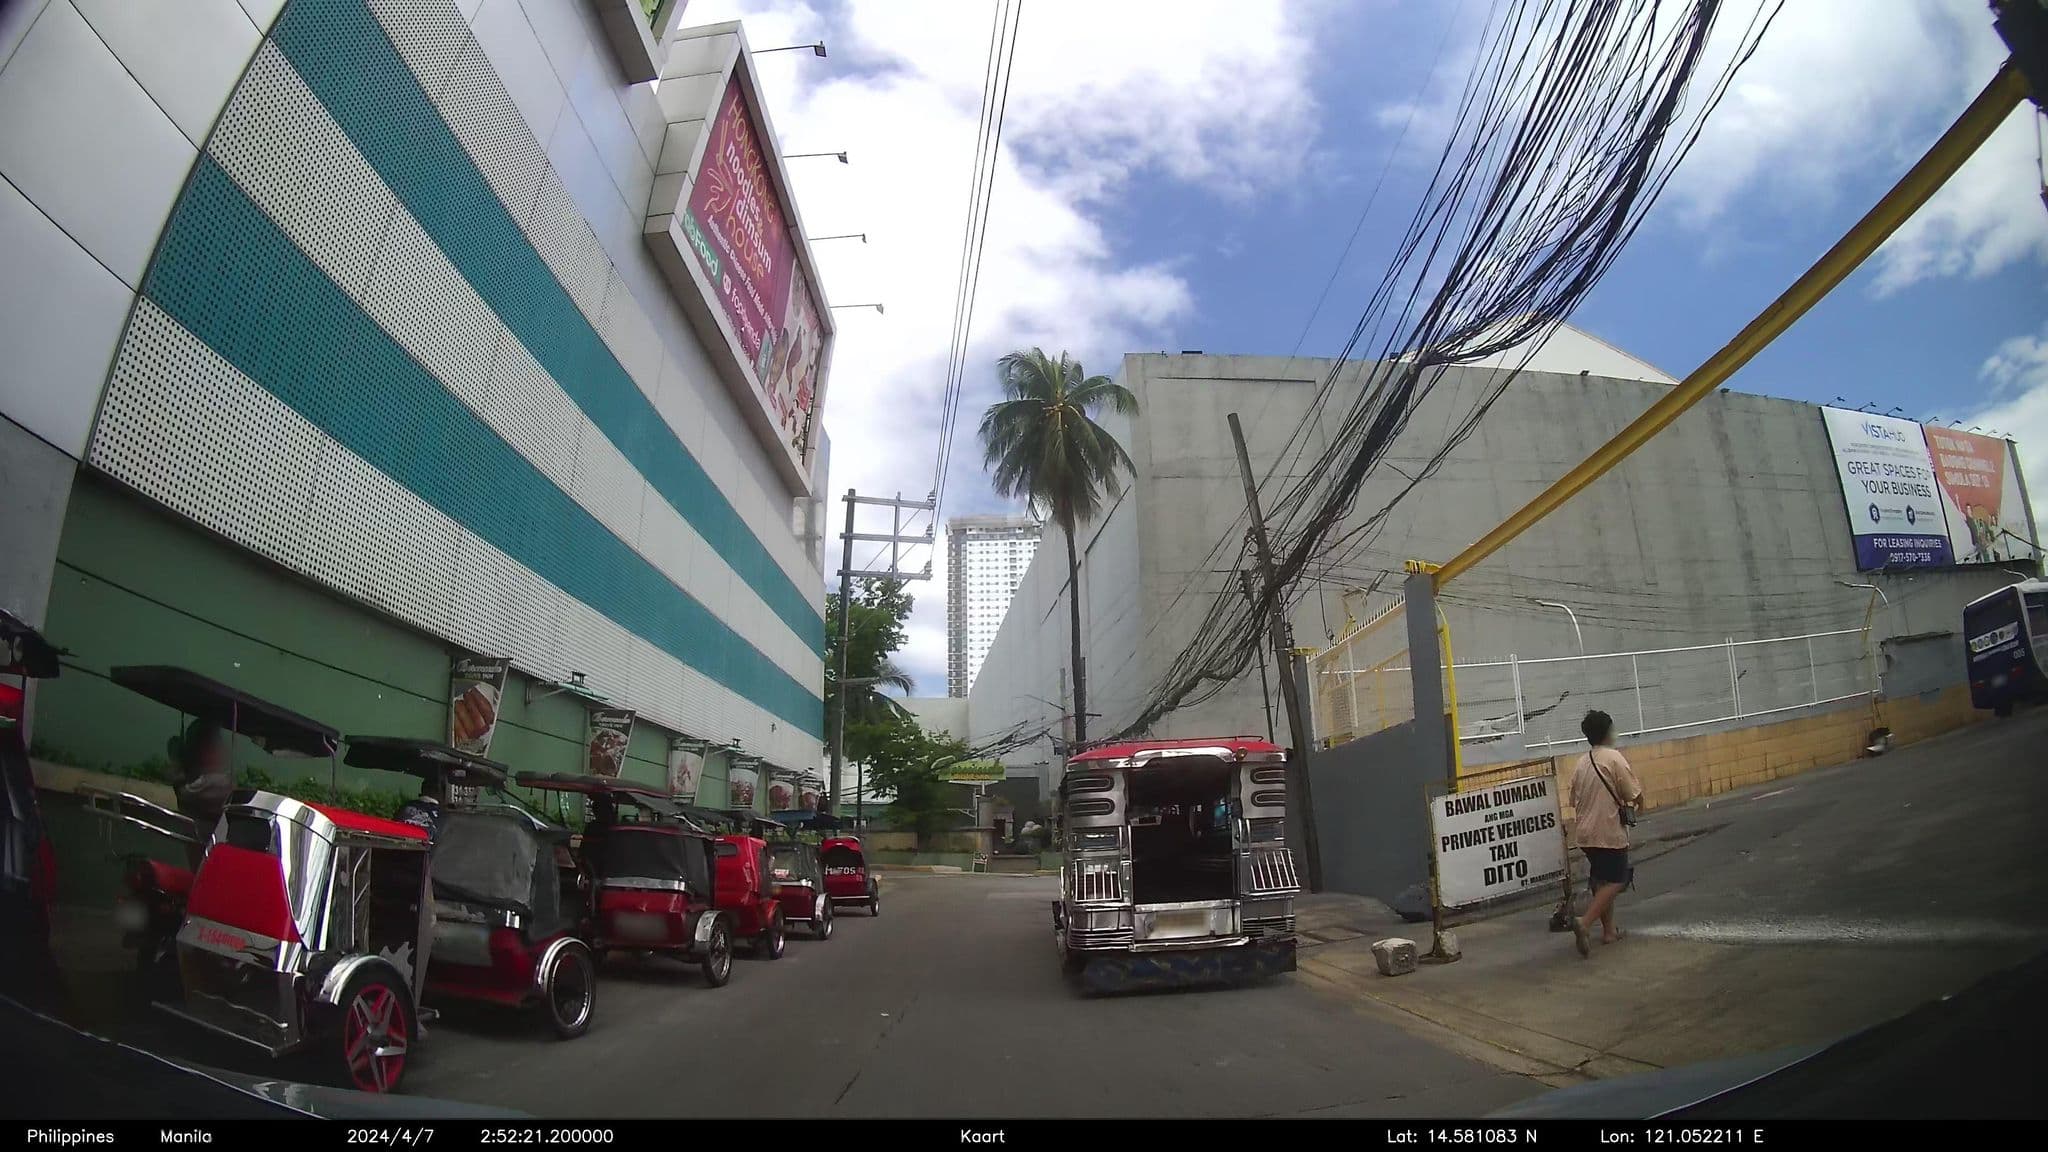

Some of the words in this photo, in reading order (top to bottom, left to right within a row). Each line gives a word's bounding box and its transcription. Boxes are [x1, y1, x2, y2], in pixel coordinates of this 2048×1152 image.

[726, 142, 760, 222] noodles
[726, 188, 764, 279] house
[736, 199, 771, 273] dimsum
[1847, 461, 1880, 476] GREAT
[1882, 463, 1916, 479] SPACES
[1861, 480, 1891, 494] YOUR
[1891, 481, 1932, 498] BUSINESS
[1873, 538, 1887, 549] FOR
[1888, 537, 1913, 549] LEASING
[1445, 793, 1492, 817] BAWAL
[1494, 781, 1547, 807] DUMAAN
[1484, 813, 1498, 823] ANG
[1499, 809, 1514, 819] MGA
[1441, 826, 1495, 853] PRIVATE
[1496, 812, 1555, 840] VEHICLES
[1489, 841, 1519, 862] TAXI
[1484, 859, 1528, 886] DITO
